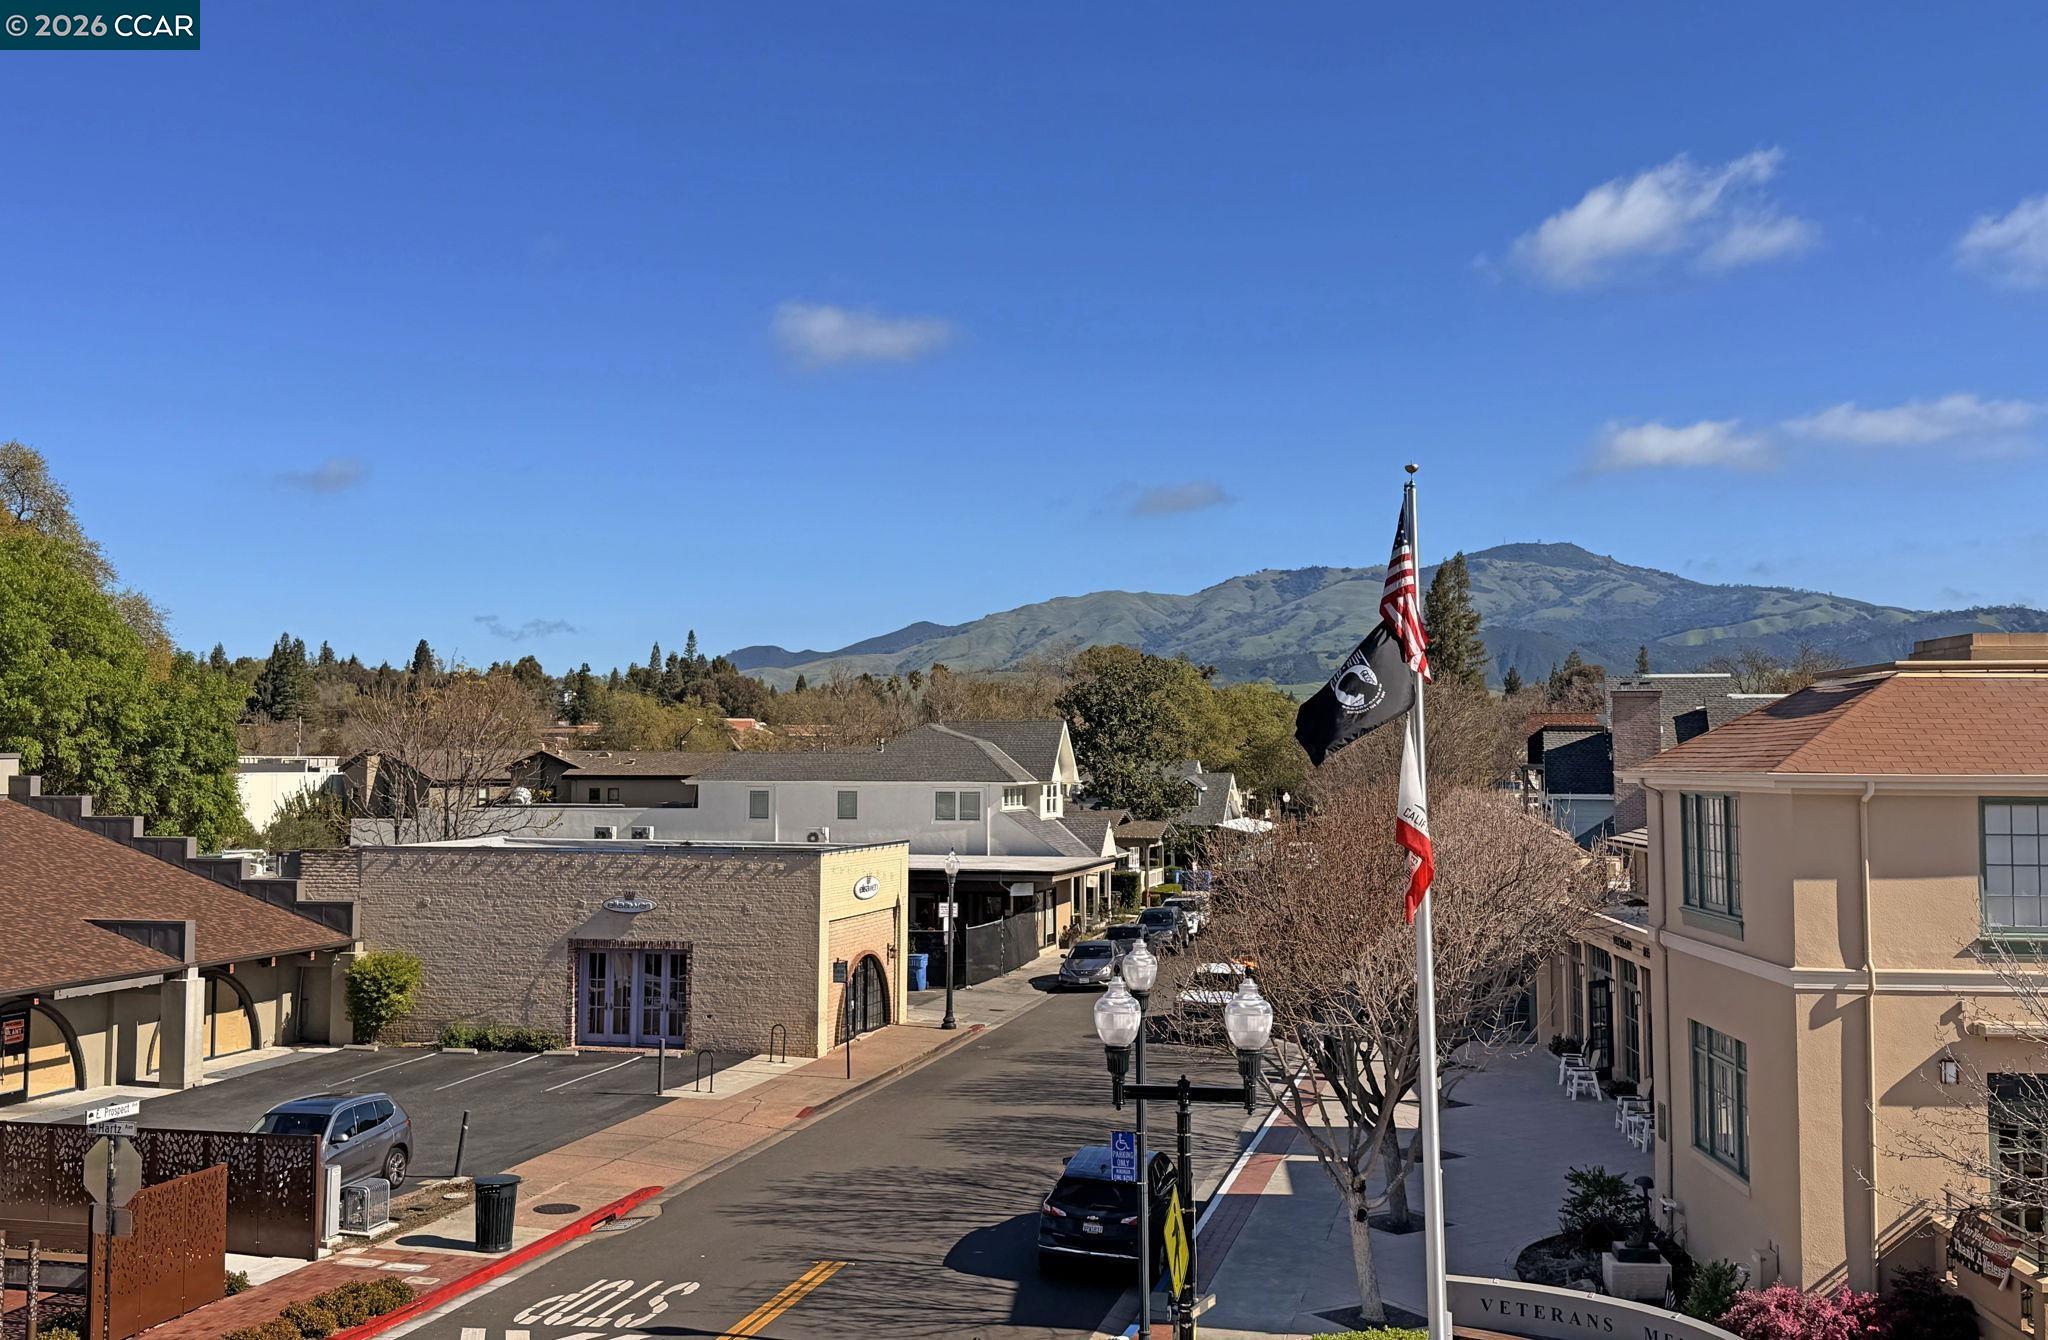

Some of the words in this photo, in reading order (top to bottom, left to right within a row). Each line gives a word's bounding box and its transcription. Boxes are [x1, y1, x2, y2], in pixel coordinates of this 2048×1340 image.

[1402, 807, 1429, 832] CALIF
[104, 1104, 130, 1118] Prospect
[98, 1122, 122, 1134] Hartz
[1112, 1151, 1134, 1159] PARKING
[1116, 1158, 1130, 1167] ONLY
[1953, 1237, 1975, 1261] Thank
[513, 1279, 701, 1329] STOP
[1480, 1298, 1614, 1333] VETERANS
[1643, 1325, 1687, 1340] ME
